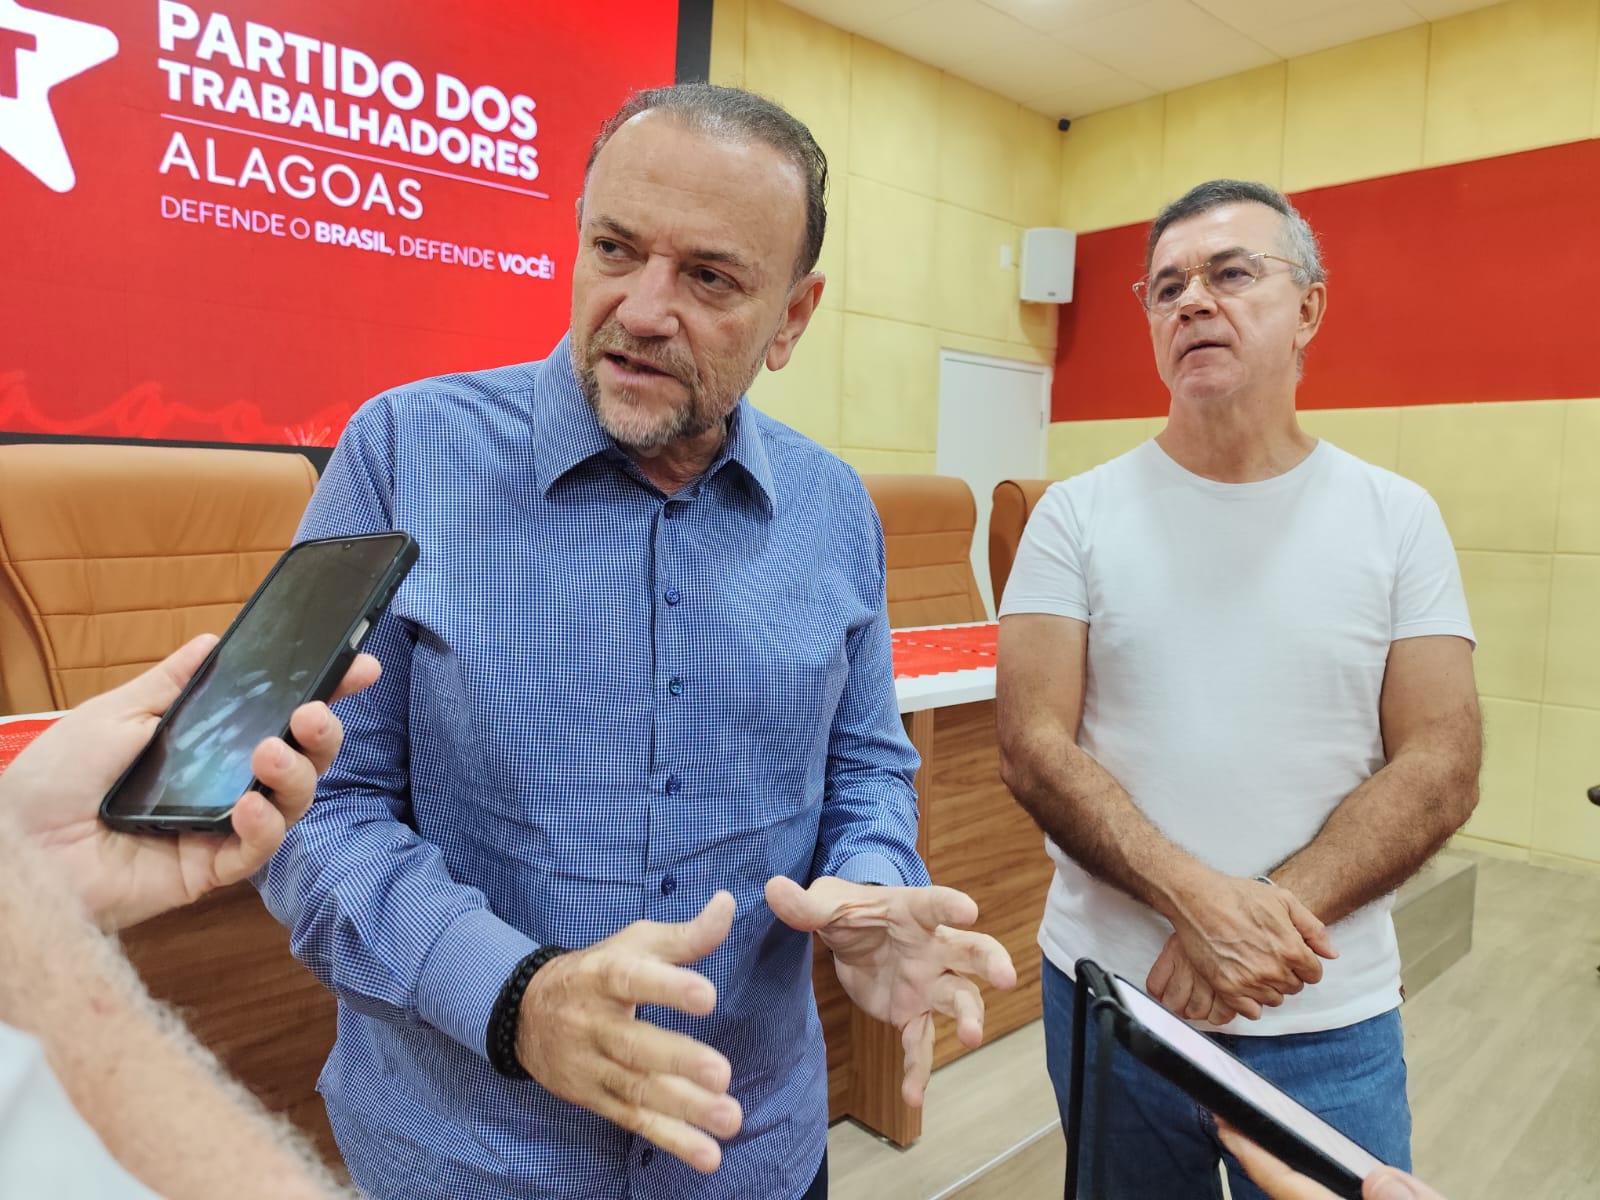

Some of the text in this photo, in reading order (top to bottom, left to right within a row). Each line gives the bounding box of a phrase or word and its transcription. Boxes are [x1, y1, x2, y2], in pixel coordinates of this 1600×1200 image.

[157, 58, 540, 181] TRABALHADORES
[158, 0, 538, 141] PARTIDO DOS
[158, 131, 424, 220] ALAGOAS
[160, 195, 555, 280] DEFENDE O BRASIL, DEFENDE VOCÊ!
